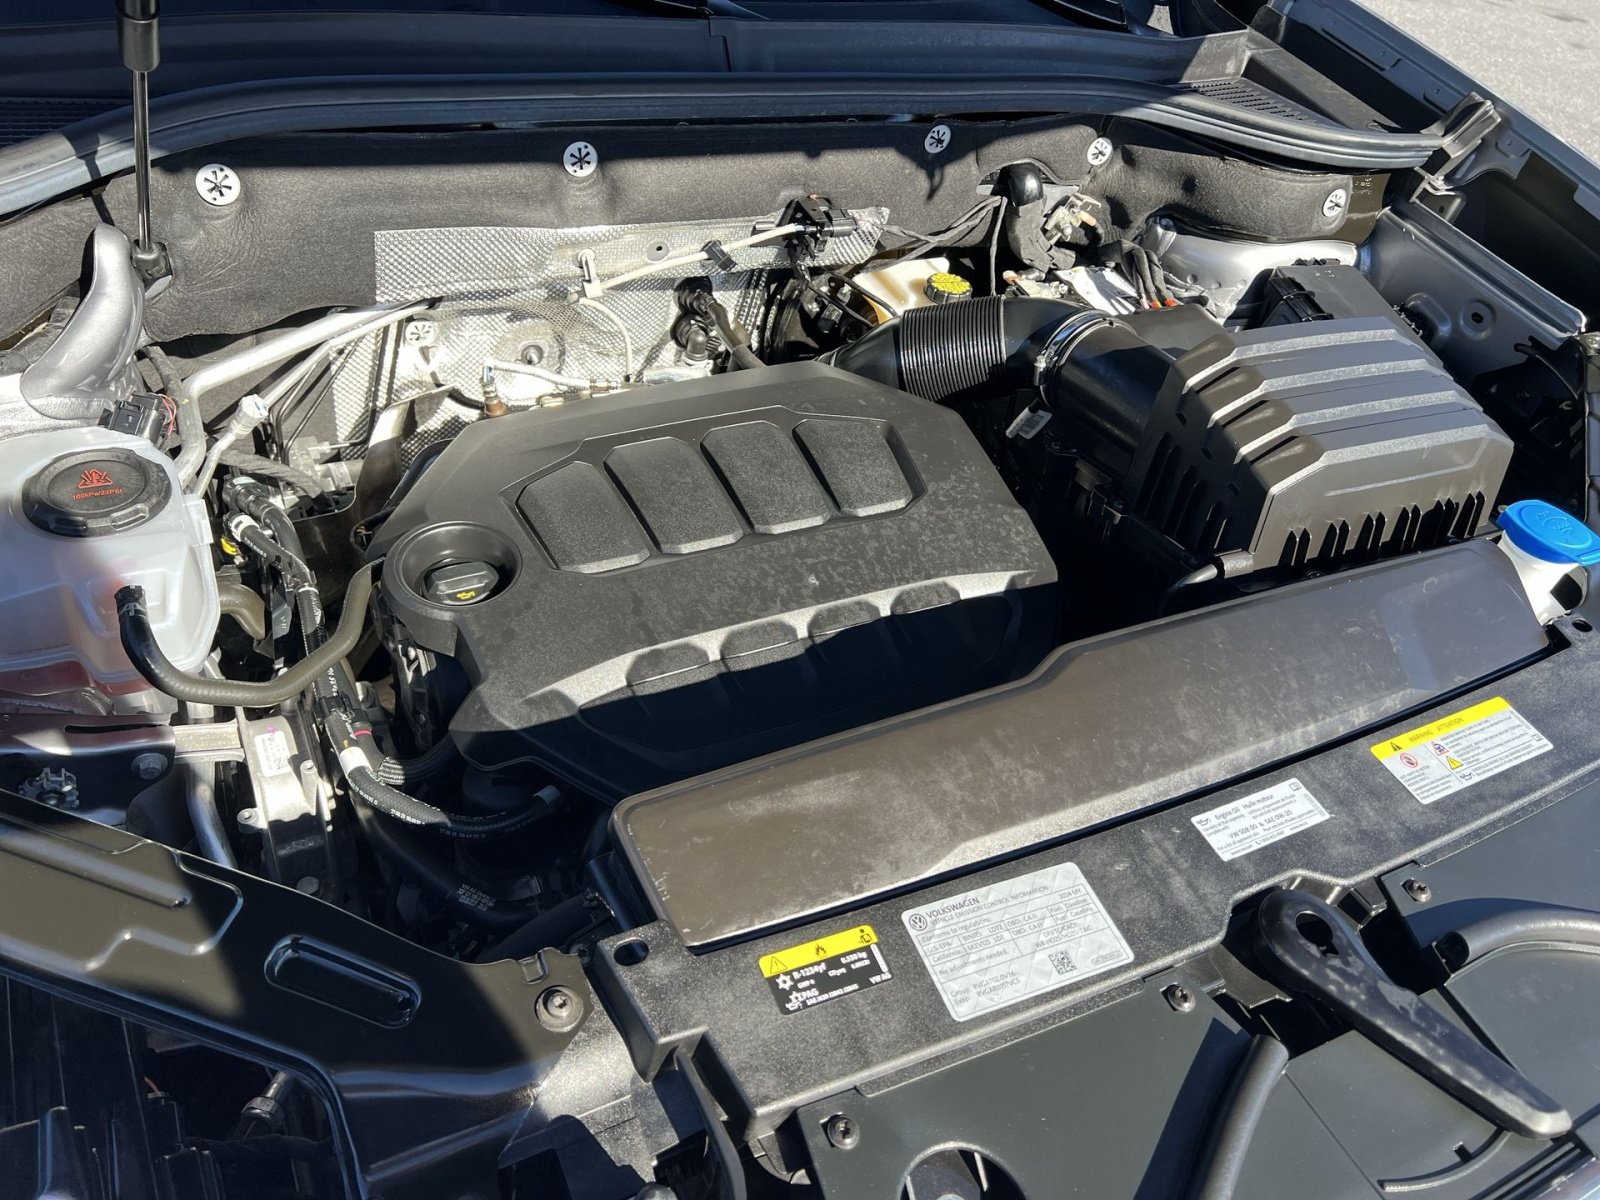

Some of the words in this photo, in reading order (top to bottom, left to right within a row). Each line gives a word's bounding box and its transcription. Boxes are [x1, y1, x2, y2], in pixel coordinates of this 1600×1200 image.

[1214, 810, 1234, 821] Engine
[1231, 806, 1241, 814] Oil
[925, 896, 980, 919] VOLKSWAGEN
[929, 913, 955, 926] VEHICLE
[954, 904, 984, 919] EMISSION
[982, 896, 1011, 910] CONTROL
[1009, 884, 1049, 901] INFORMATION
[791, 962, 827, 980] R-1234yf
